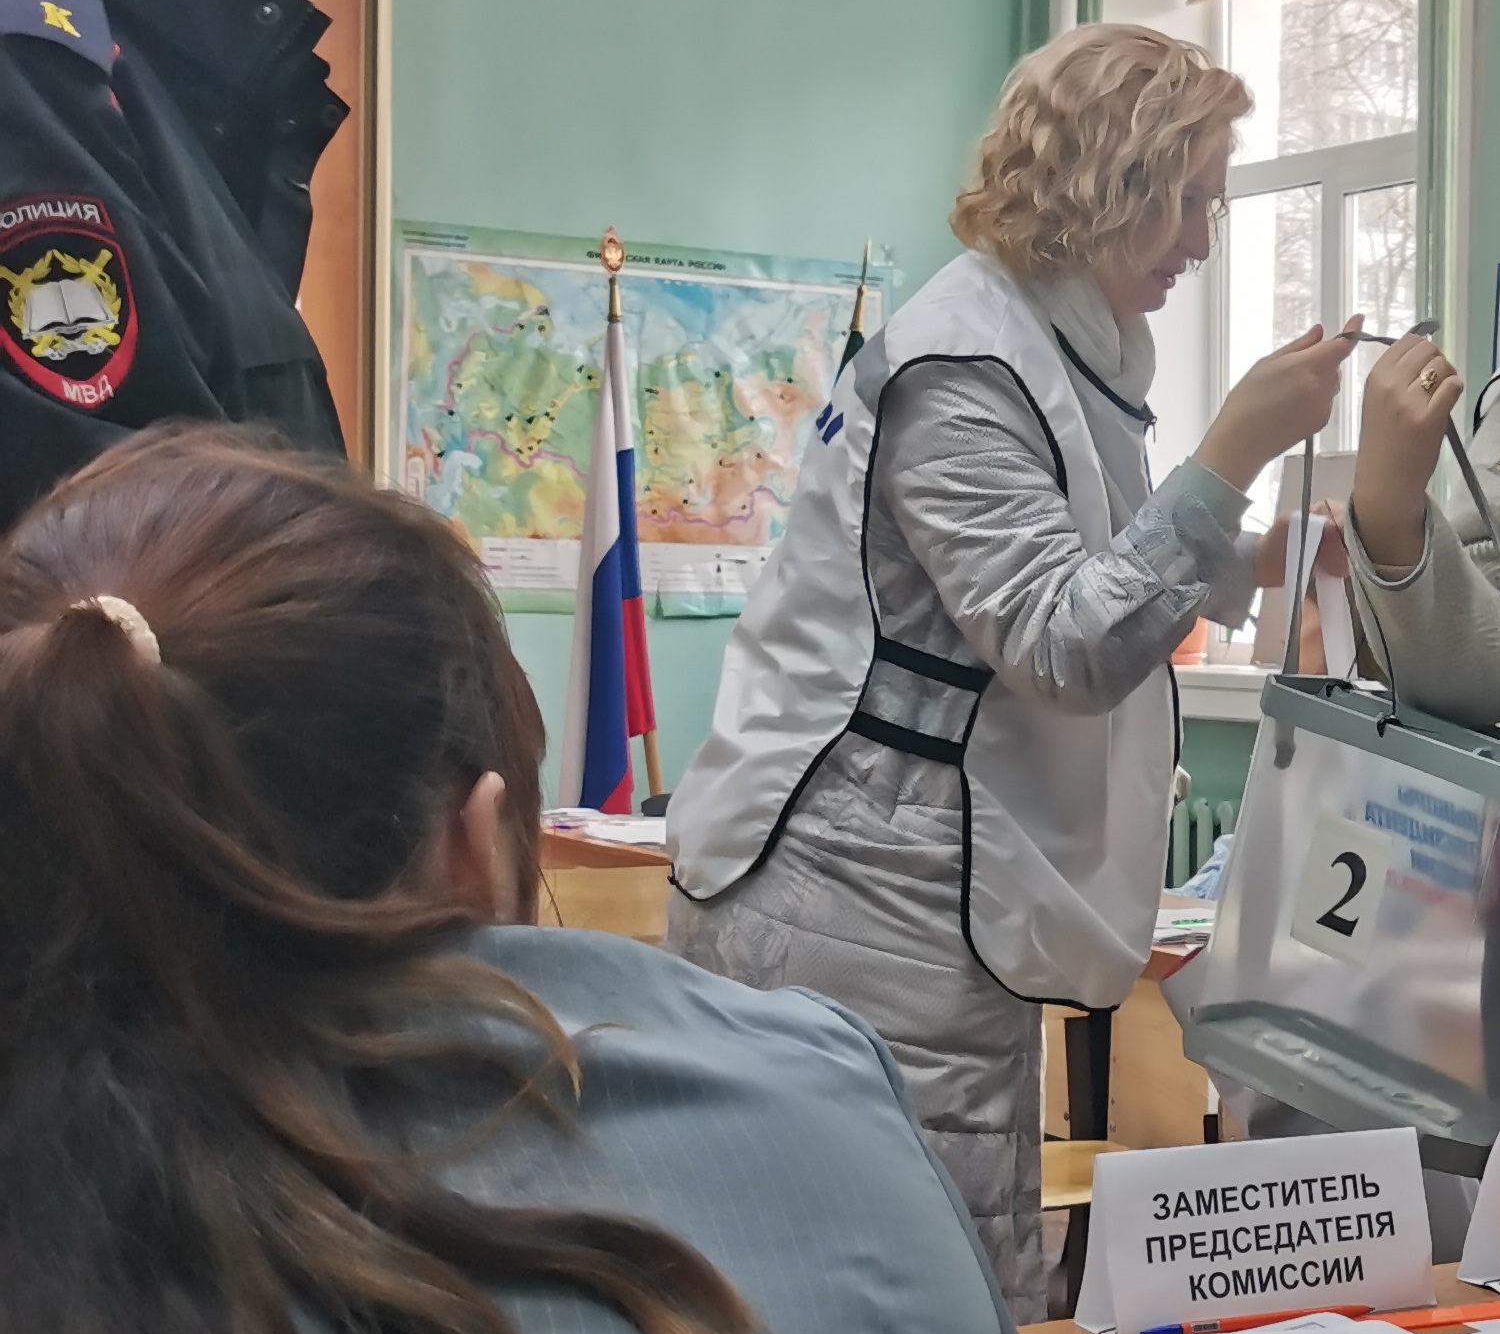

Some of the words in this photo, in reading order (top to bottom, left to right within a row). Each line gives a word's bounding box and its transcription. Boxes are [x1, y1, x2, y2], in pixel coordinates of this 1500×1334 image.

[0, 200, 101, 228] ОЛИЦИЯ
[62, 375, 114, 403] МВД
[1315, 851, 1367, 937] 2
[1152, 1173, 1381, 1221] ЗАМЕСТИТЕЛЬ
[1145, 1210, 1396, 1264] ПРЕДСЕДАТЕЛЯ
[1188, 1255, 1365, 1302] КОМИССИИ
